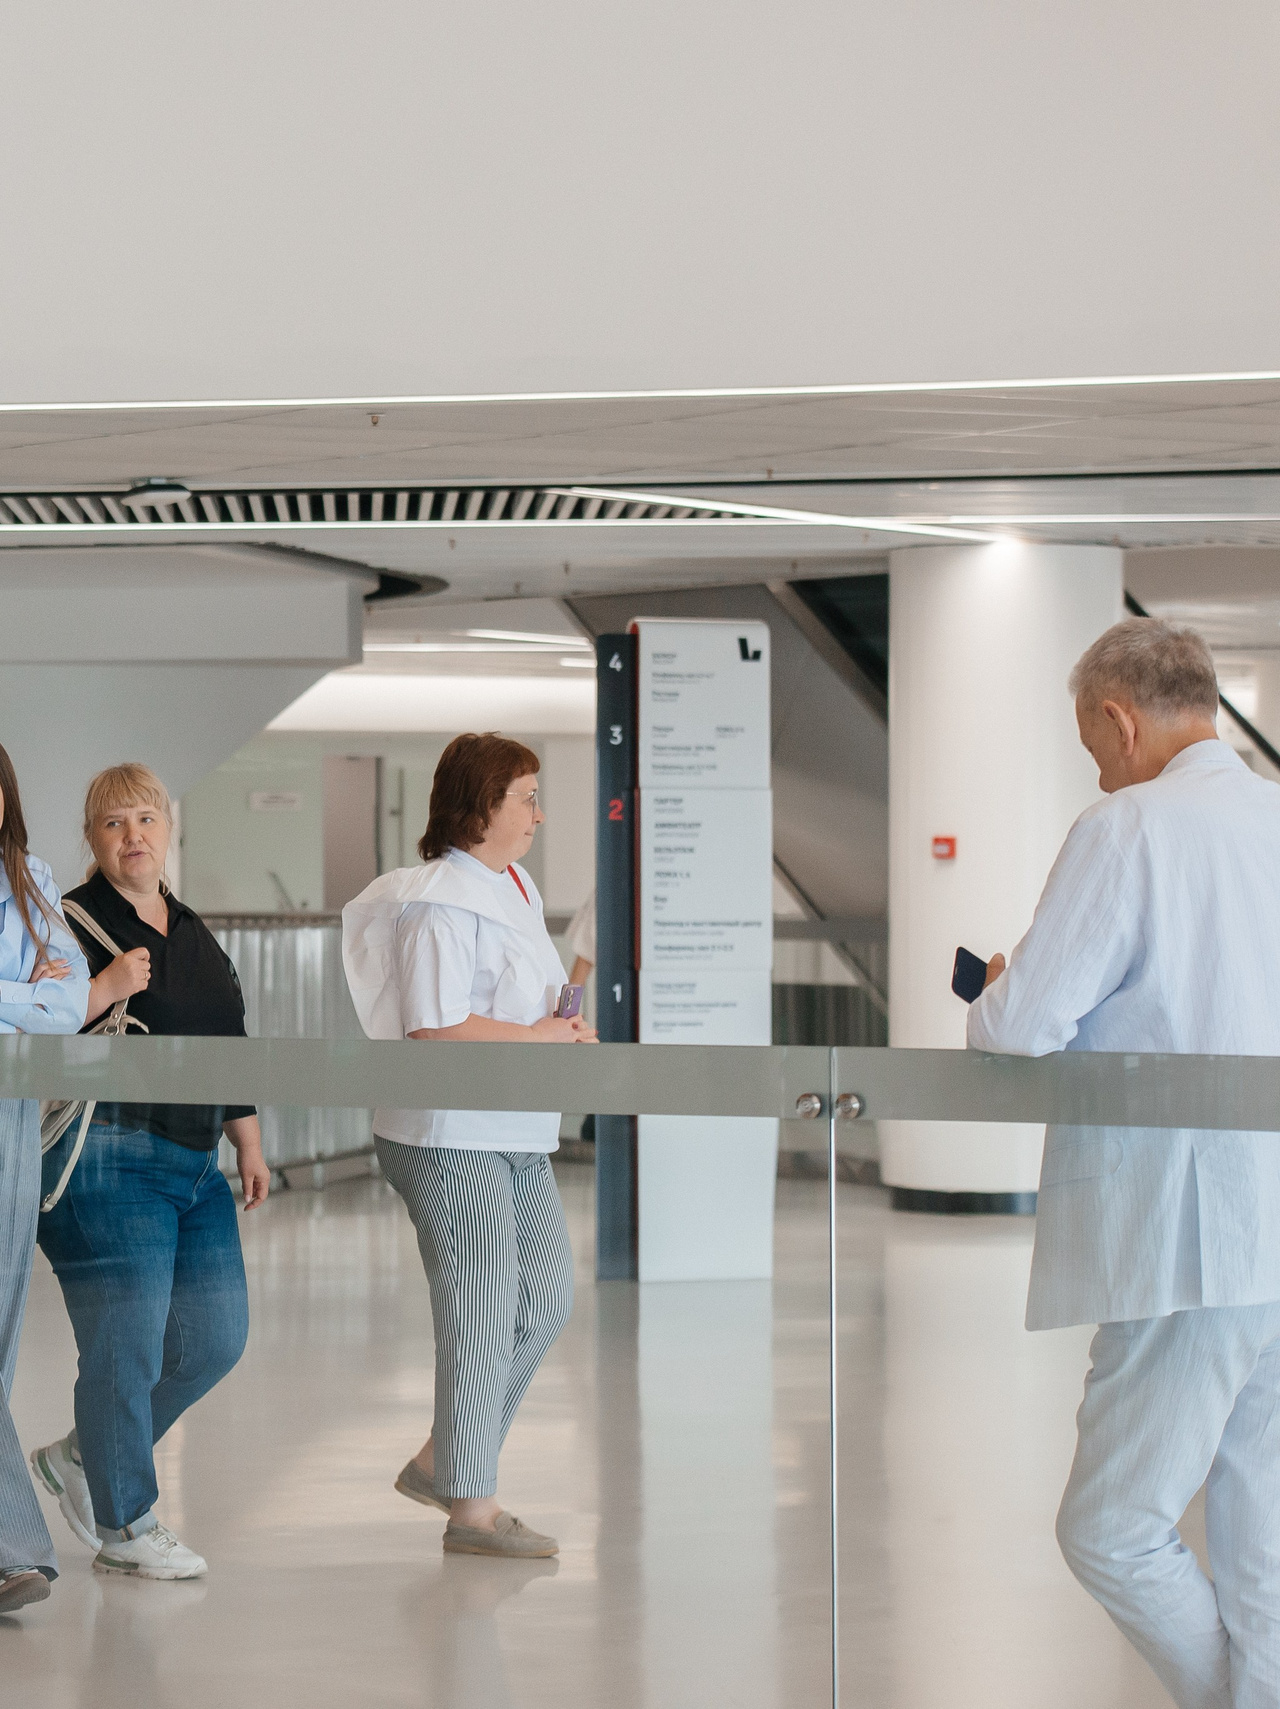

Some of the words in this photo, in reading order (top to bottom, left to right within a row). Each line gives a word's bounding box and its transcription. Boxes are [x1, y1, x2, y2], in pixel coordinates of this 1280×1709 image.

[609, 652, 623, 672] 4
[609, 724, 623, 746] 3
[608, 798, 624, 821] 2
[612, 983, 622, 1003] 1
